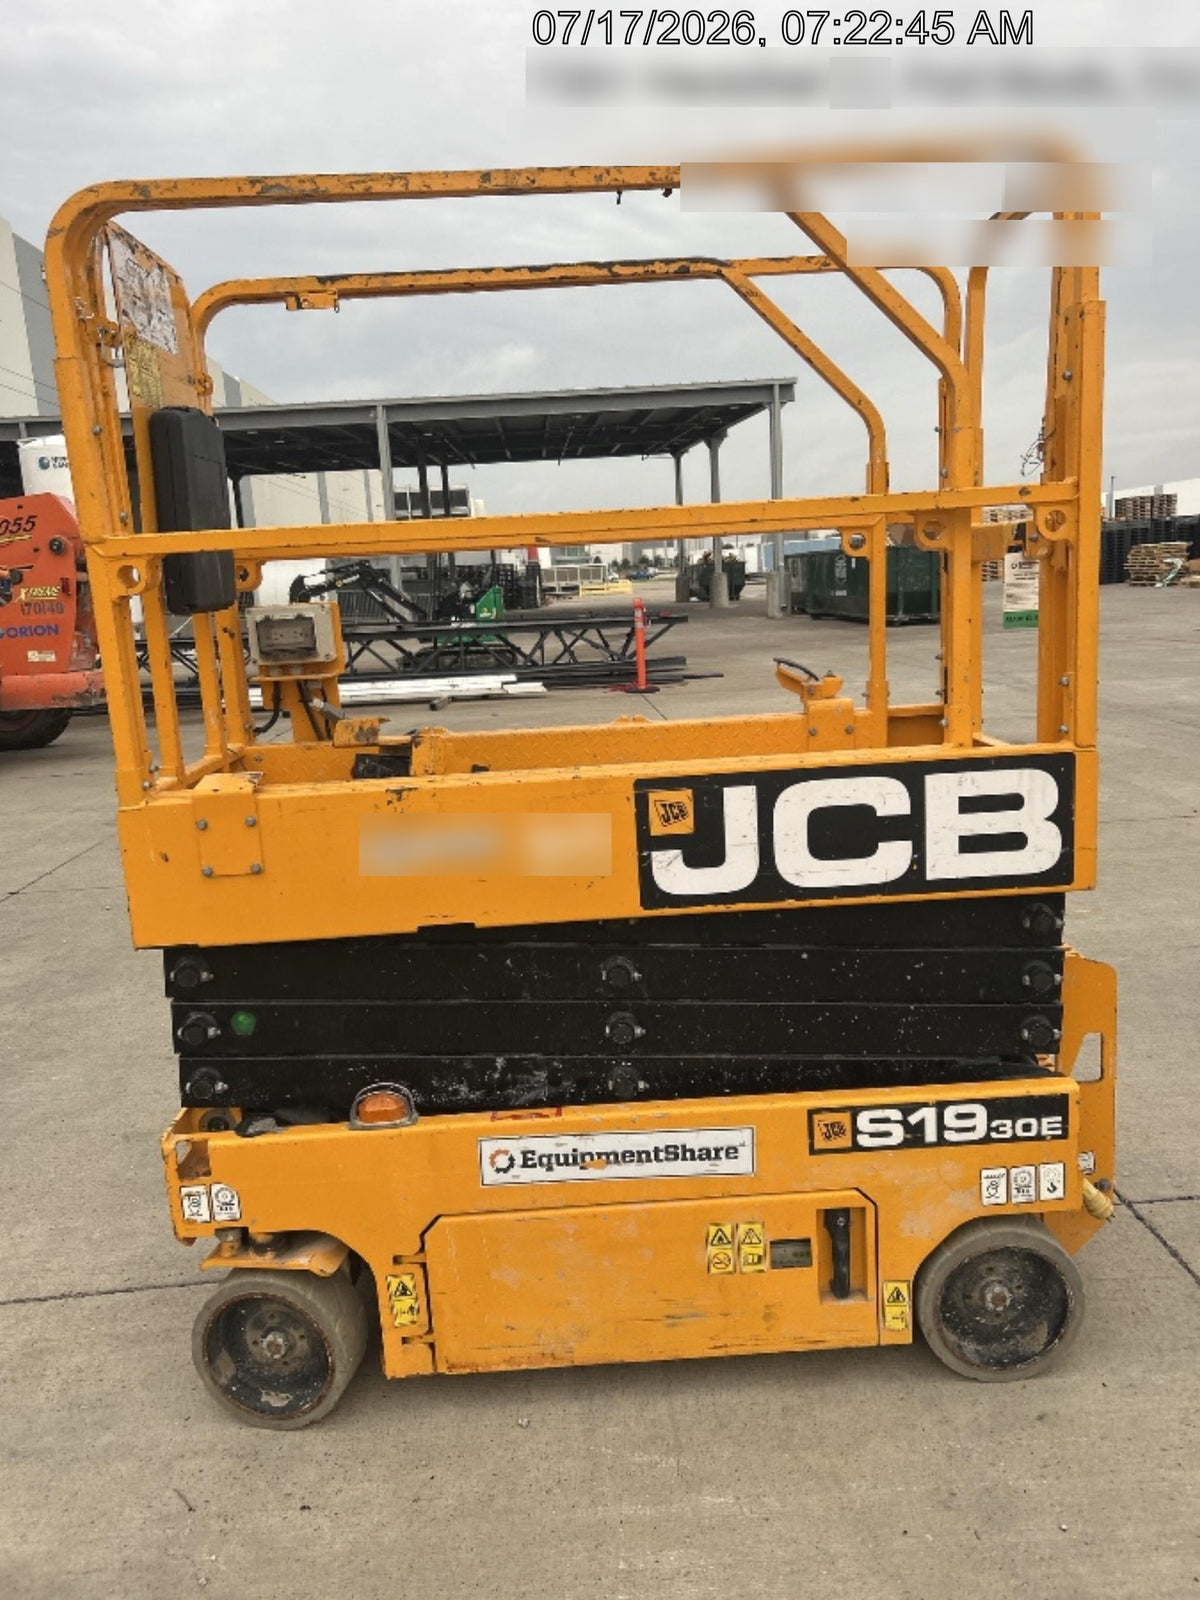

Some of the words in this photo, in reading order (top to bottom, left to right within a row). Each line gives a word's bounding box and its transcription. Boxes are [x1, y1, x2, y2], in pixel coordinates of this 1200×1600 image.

[660, 802, 688, 823] JCB
[651, 768, 1063, 896] JCB
[520, 1144, 739, 1171] EquipmentShare
